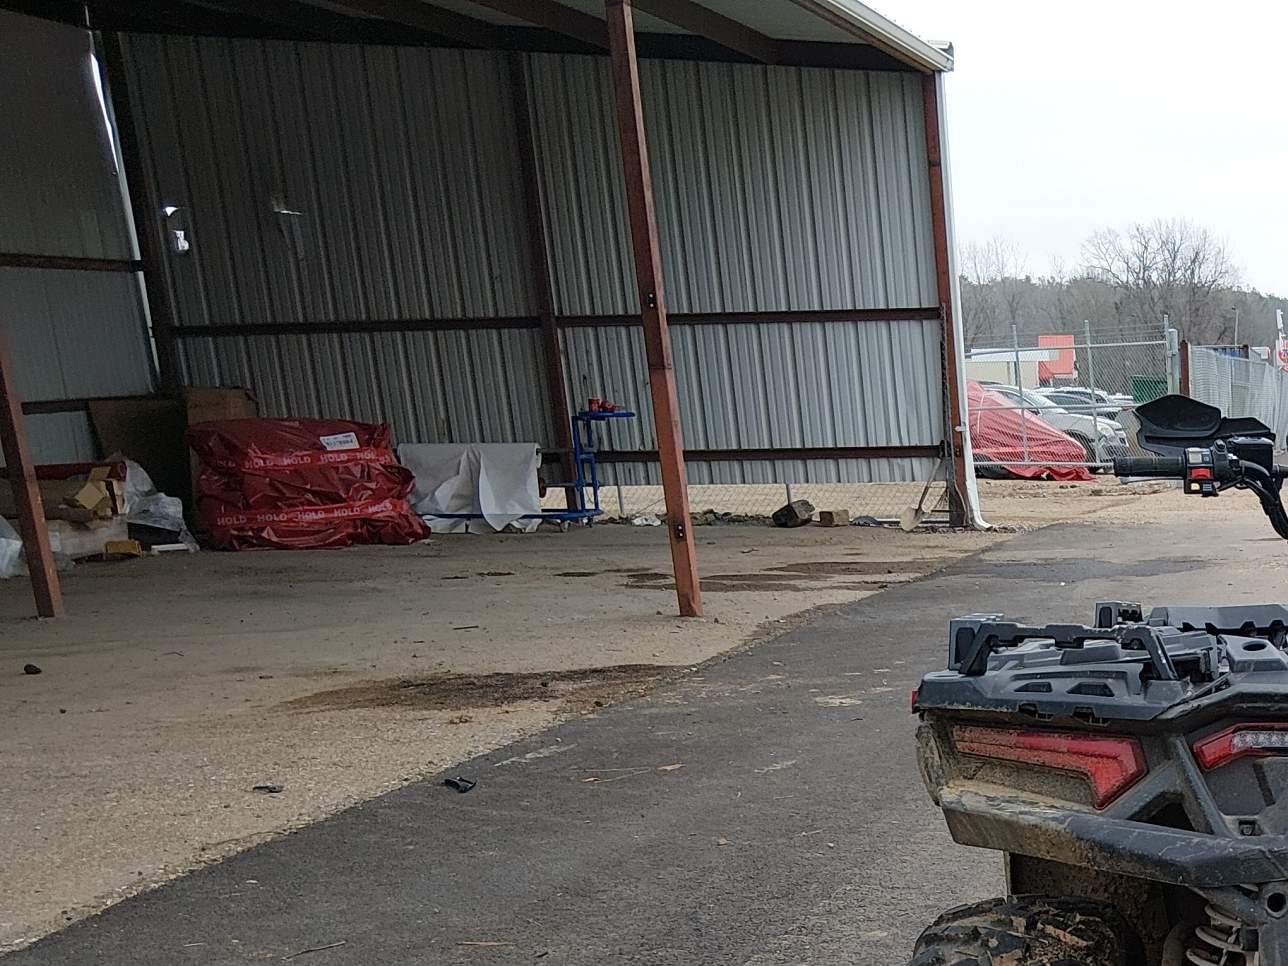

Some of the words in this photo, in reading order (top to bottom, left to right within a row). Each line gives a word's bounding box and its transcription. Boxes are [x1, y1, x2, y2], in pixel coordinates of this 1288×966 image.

[283, 455, 311, 465] HOLD
[320, 453, 348, 463] HOLD
[217, 515, 247, 526] HOLD
[256, 512, 288, 522] HOLD
[297, 510, 325, 521] HOLD
[333, 507, 361, 517] HOLD
